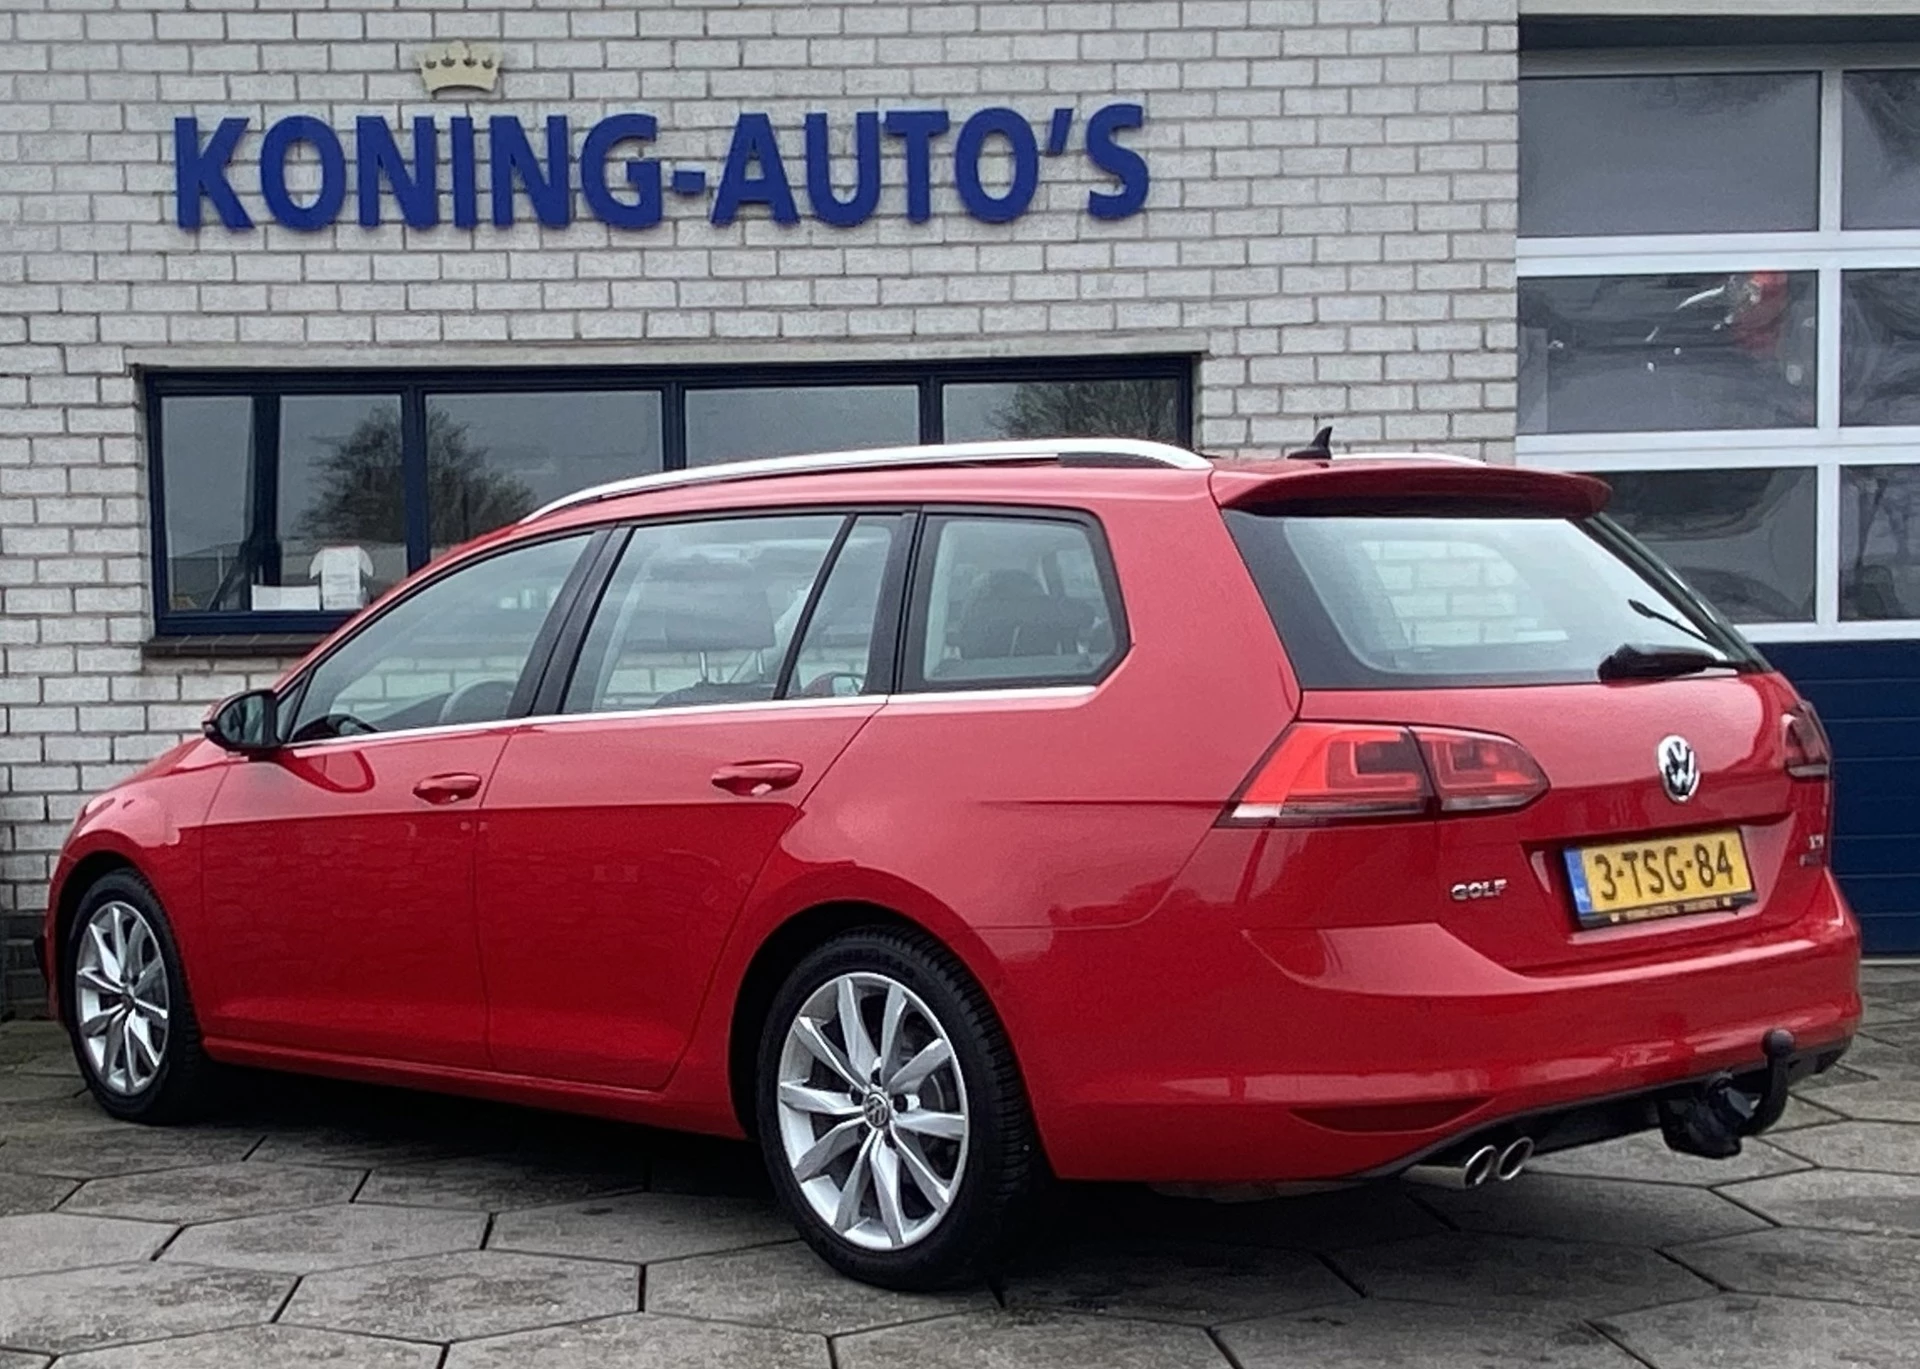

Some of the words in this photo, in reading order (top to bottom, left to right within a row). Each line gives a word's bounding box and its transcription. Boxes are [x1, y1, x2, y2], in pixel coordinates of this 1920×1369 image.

[174, 103, 1150, 232] KONING-AUTO'S
[1450, 878, 1507, 901] GOLF
[1594, 840, 1734, 901] 3-TSG-84
